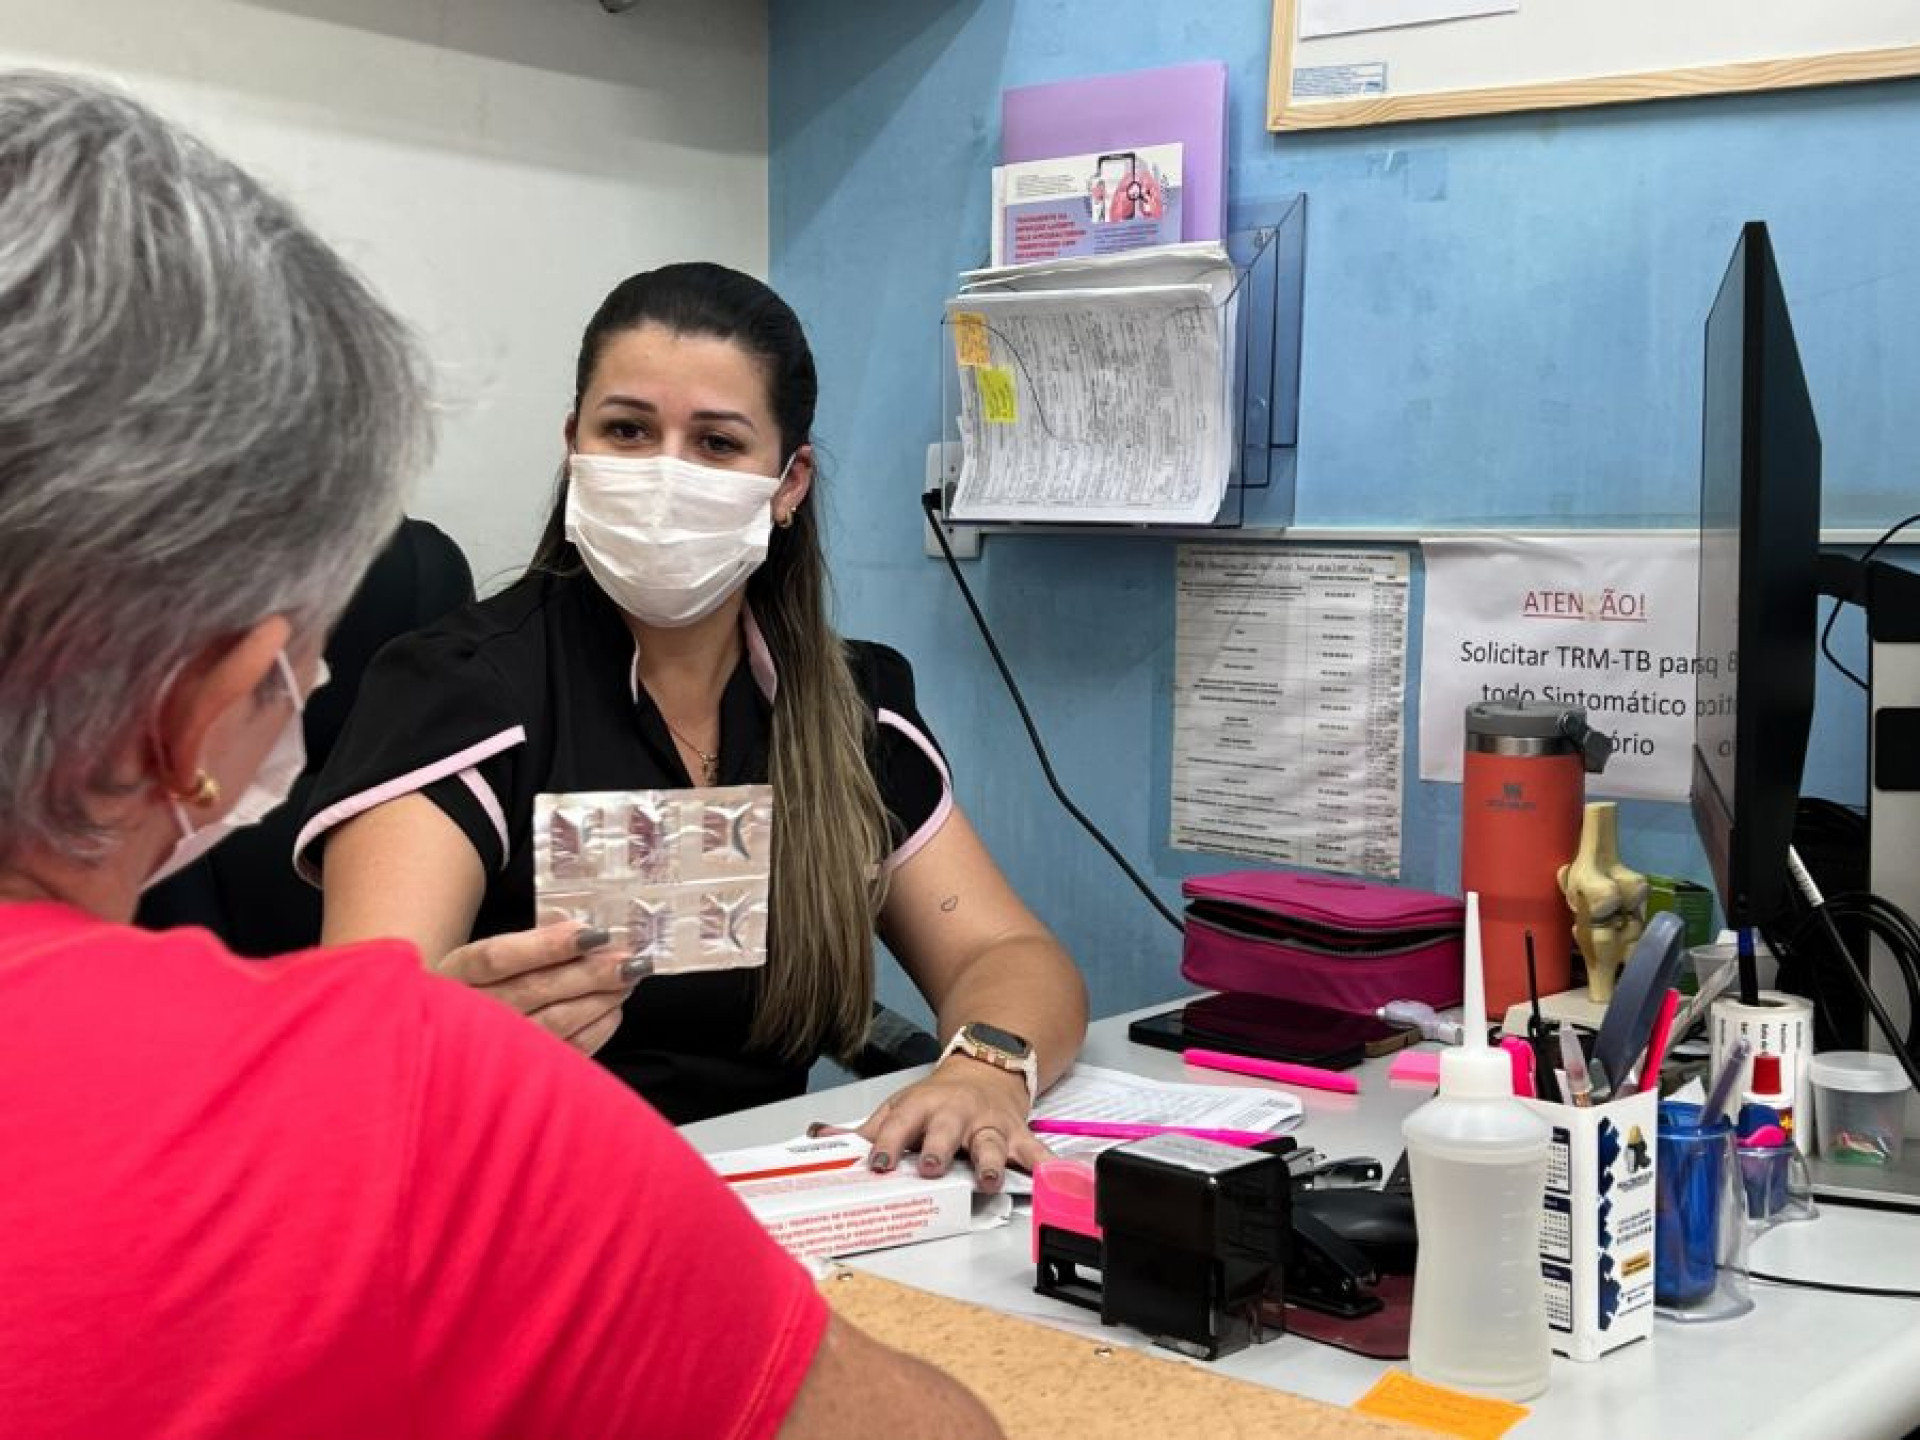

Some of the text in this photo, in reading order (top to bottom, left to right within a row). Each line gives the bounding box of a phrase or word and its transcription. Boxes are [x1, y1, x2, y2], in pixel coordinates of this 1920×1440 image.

[1524, 588, 1647, 621] ATENÃO!
[1460, 641, 1549, 667] Solicitar
[1556, 646, 1651, 672] TRM-TB
[1542, 685, 1686, 716] Sintomático
